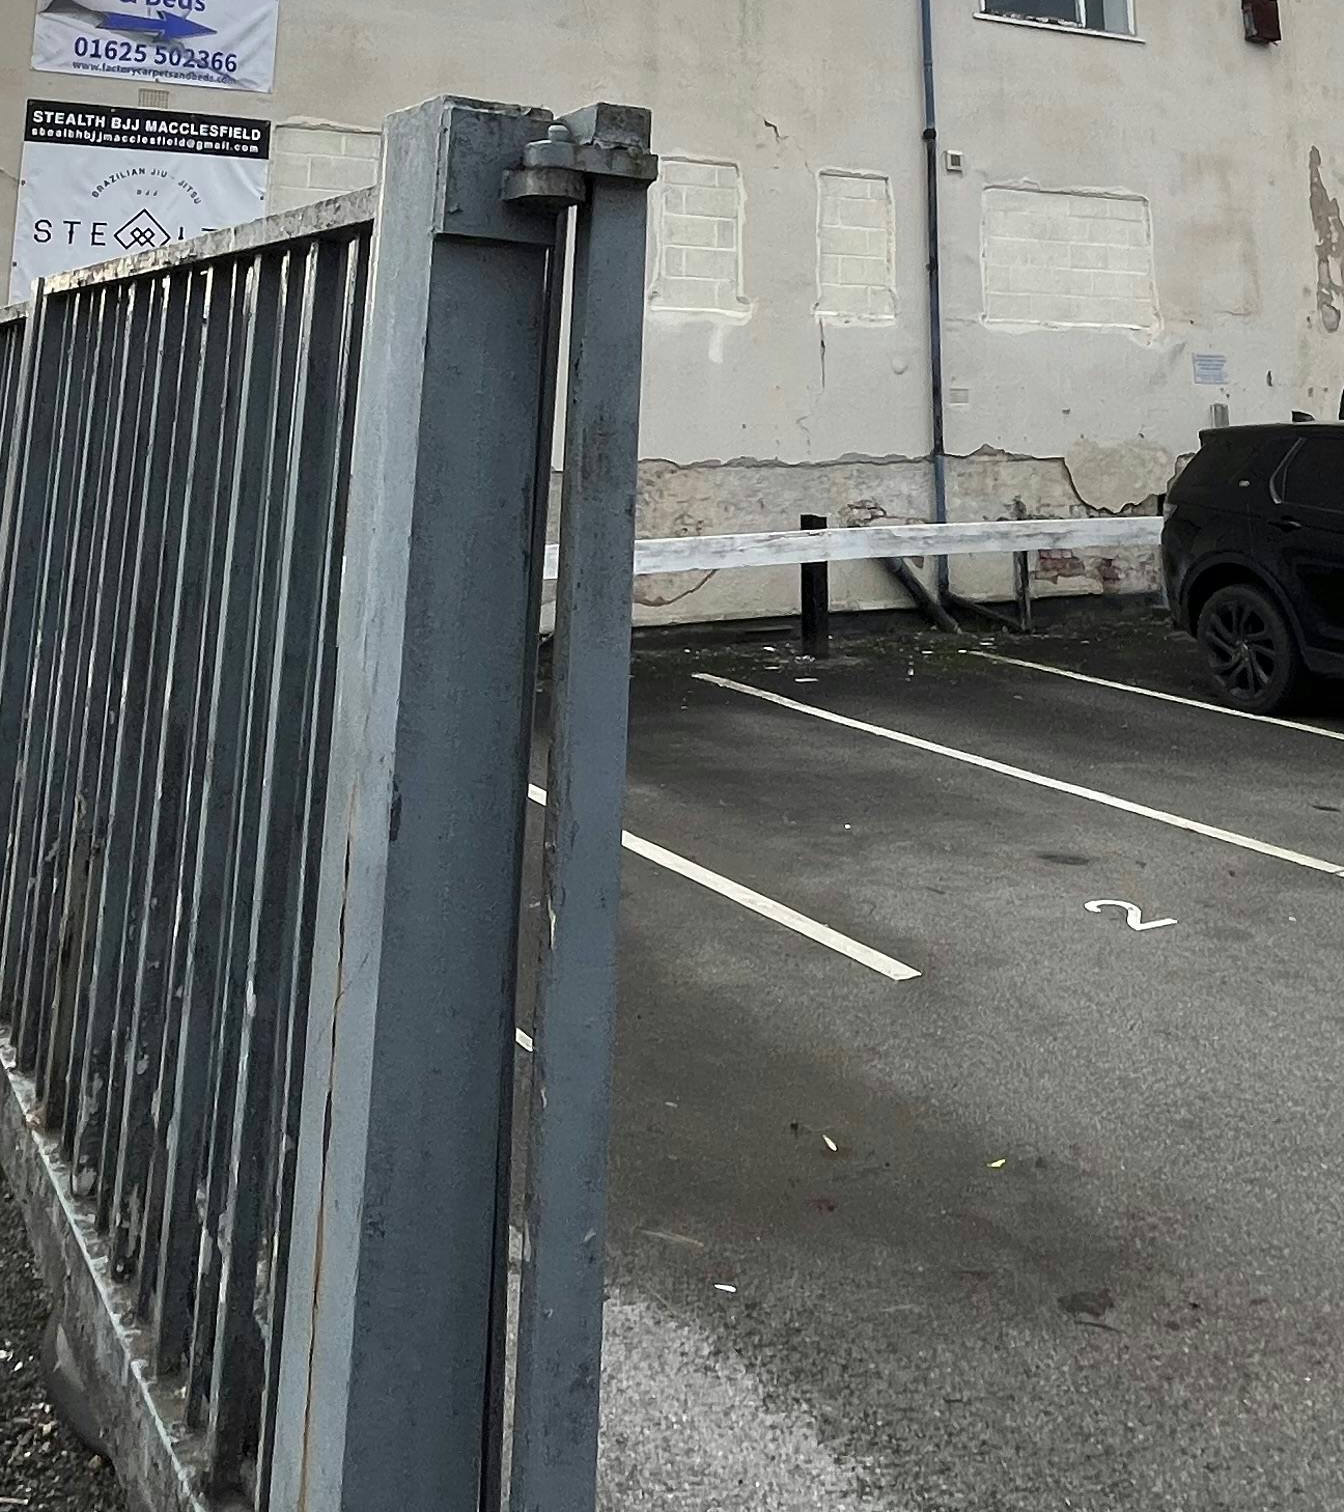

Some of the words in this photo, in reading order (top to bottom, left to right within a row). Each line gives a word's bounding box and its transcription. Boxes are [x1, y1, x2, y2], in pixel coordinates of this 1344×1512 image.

[74, 37, 147, 63] 01625
[154, 44, 238, 73] 502366
[31, 127, 259, 153] stealthbjjmacclesfield@gmail.com
[32, 110, 106, 128] STEALTH
[111, 117, 140, 131] BJJ
[145, 119, 261, 141] MACCLESFIELD
[91, 168, 146, 198] BRAZILIAN
[150, 169, 168, 178] JIU
[177, 180, 201, 204] JITSU
[1084, 899, 1178, 931] 2
